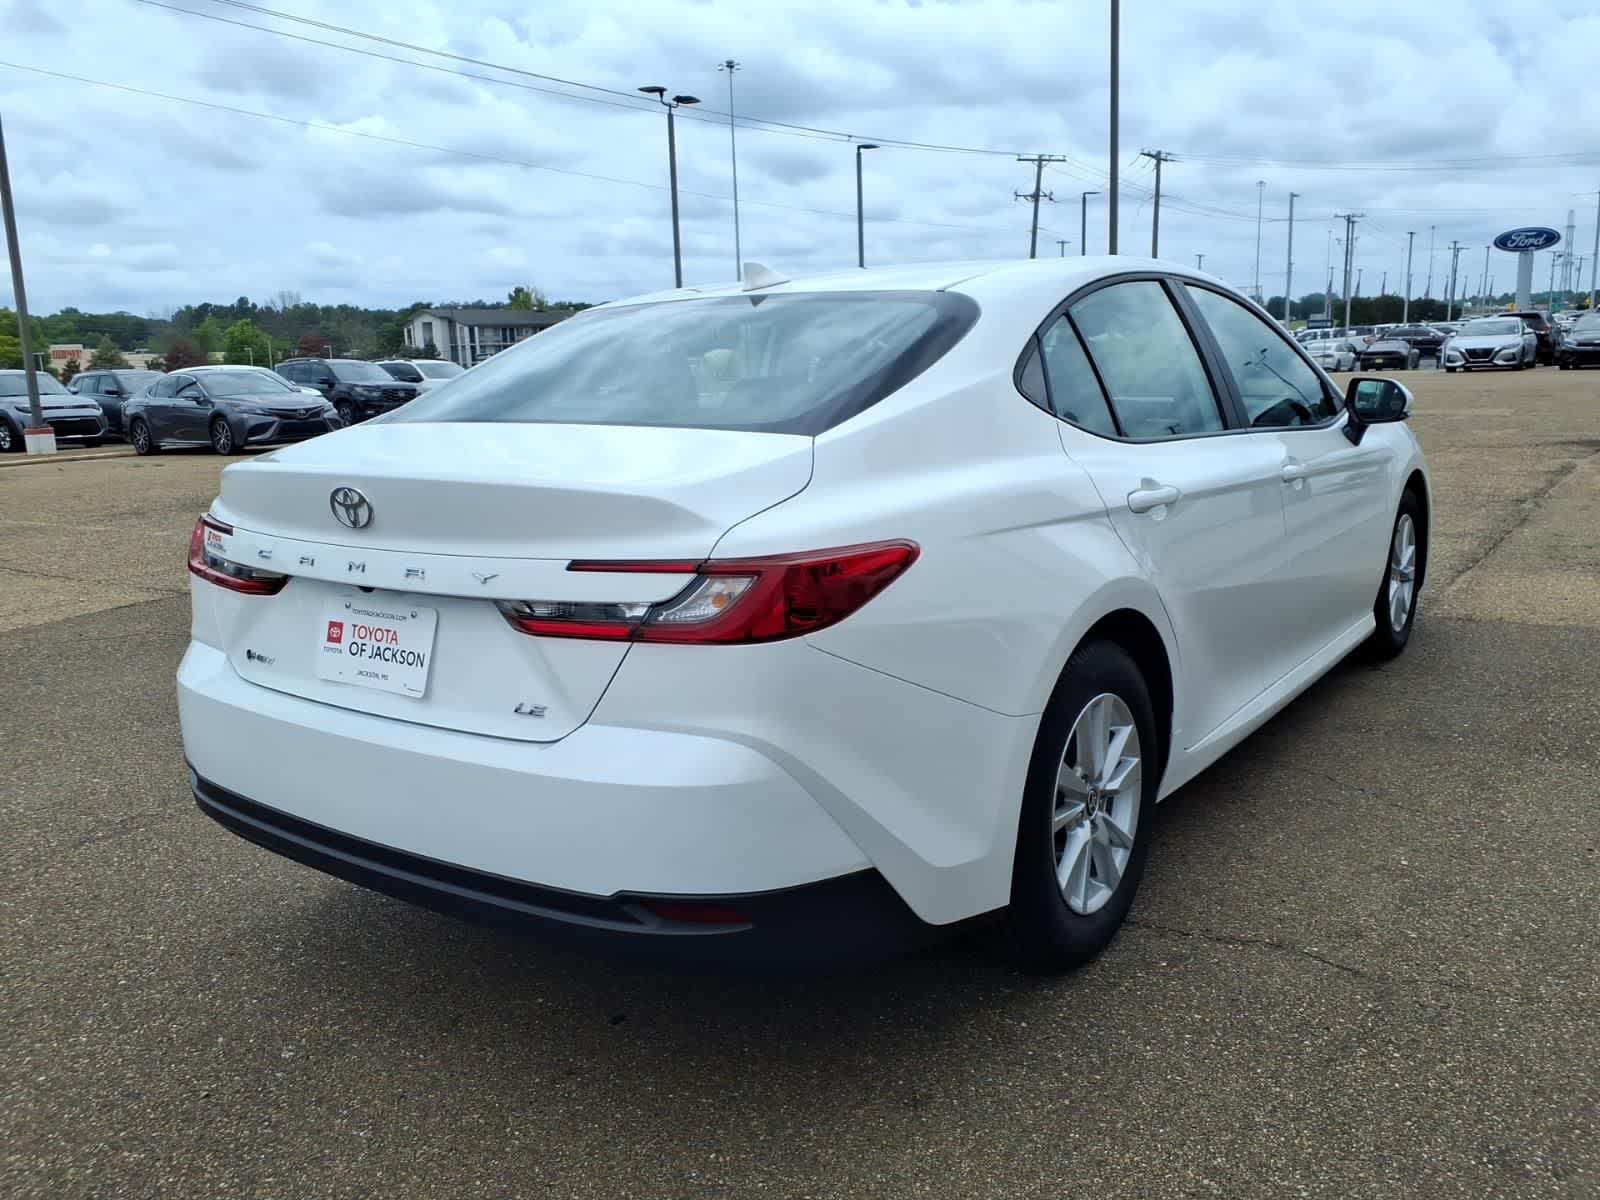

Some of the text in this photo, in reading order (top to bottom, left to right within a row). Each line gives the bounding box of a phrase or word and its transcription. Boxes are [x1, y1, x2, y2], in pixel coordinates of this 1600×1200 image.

[1507, 231, 1546, 247] Ford
[257, 549, 499, 585] CAMRY
[351, 623, 399, 646] TOYOTA
[348, 641, 425, 668] OF JACKSON
[514, 702, 548, 717] LE
